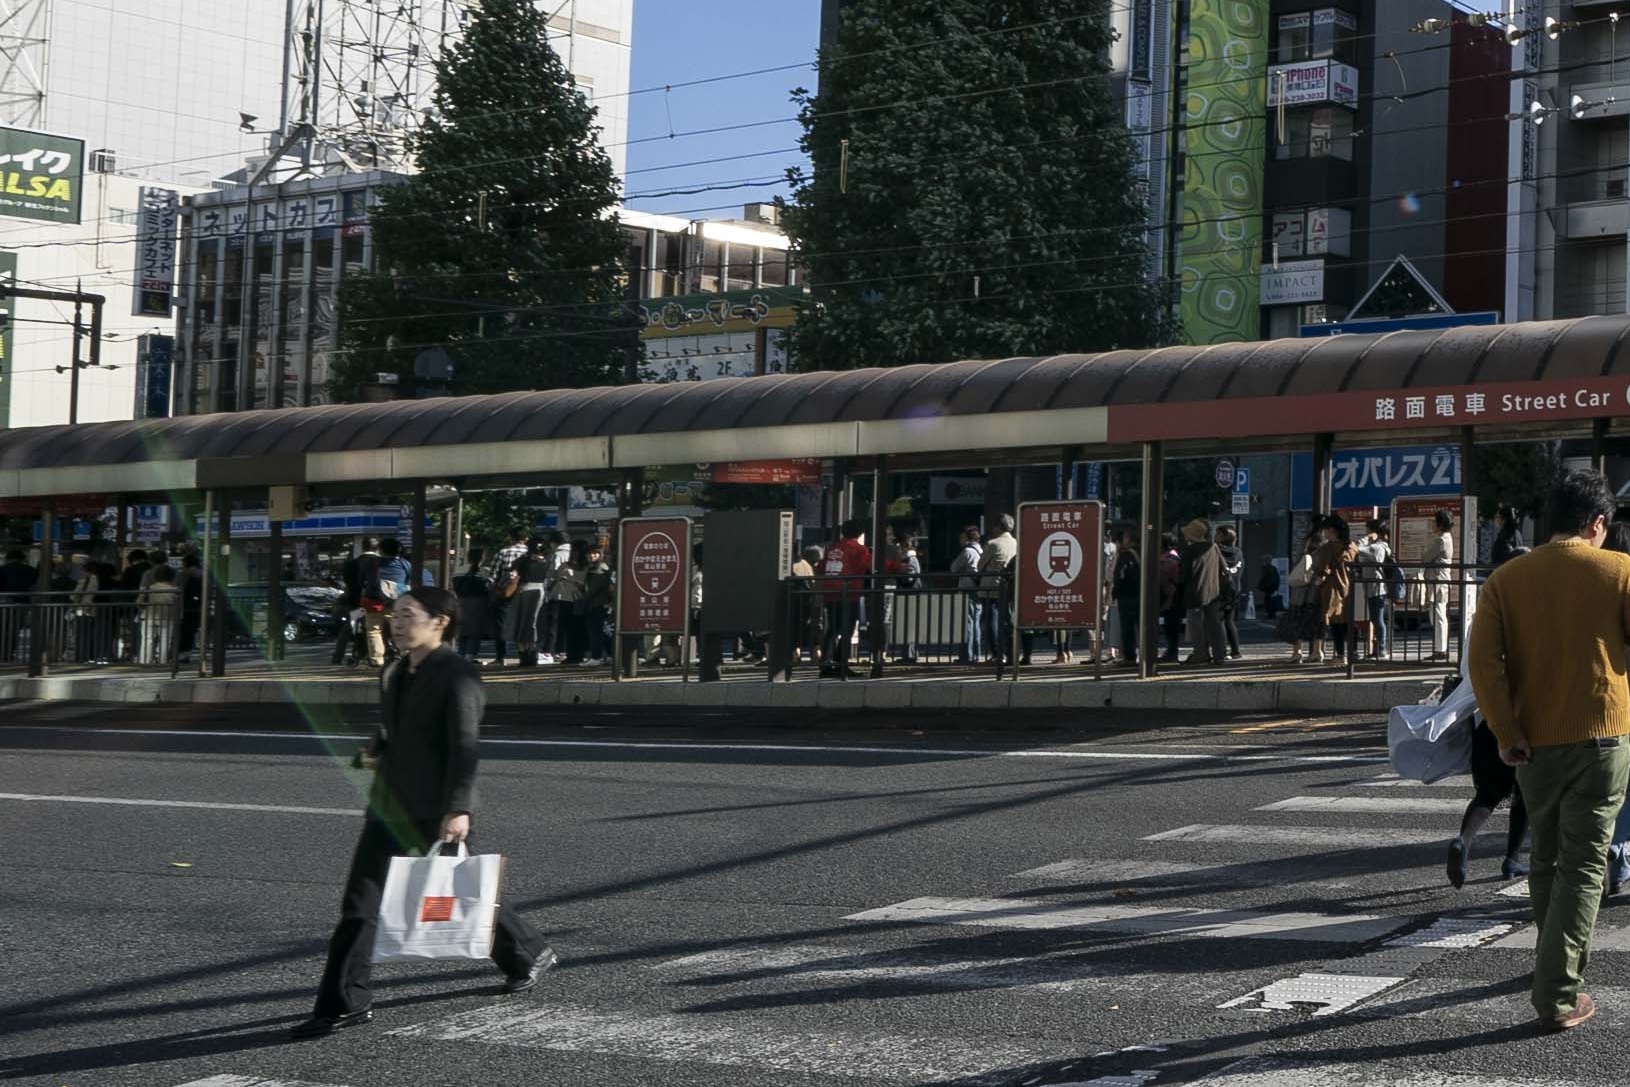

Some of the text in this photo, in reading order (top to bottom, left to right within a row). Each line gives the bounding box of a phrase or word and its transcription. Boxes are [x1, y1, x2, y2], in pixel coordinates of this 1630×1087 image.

[1266, 275, 1317, 290] IMPACT
[1375, 387, 1611, 420] 路面電車 Street Car
[1332, 448, 1461, 489] オパレス21
[1237, 471, 1247, 492] P
[232, 521, 264, 530] AWSON
